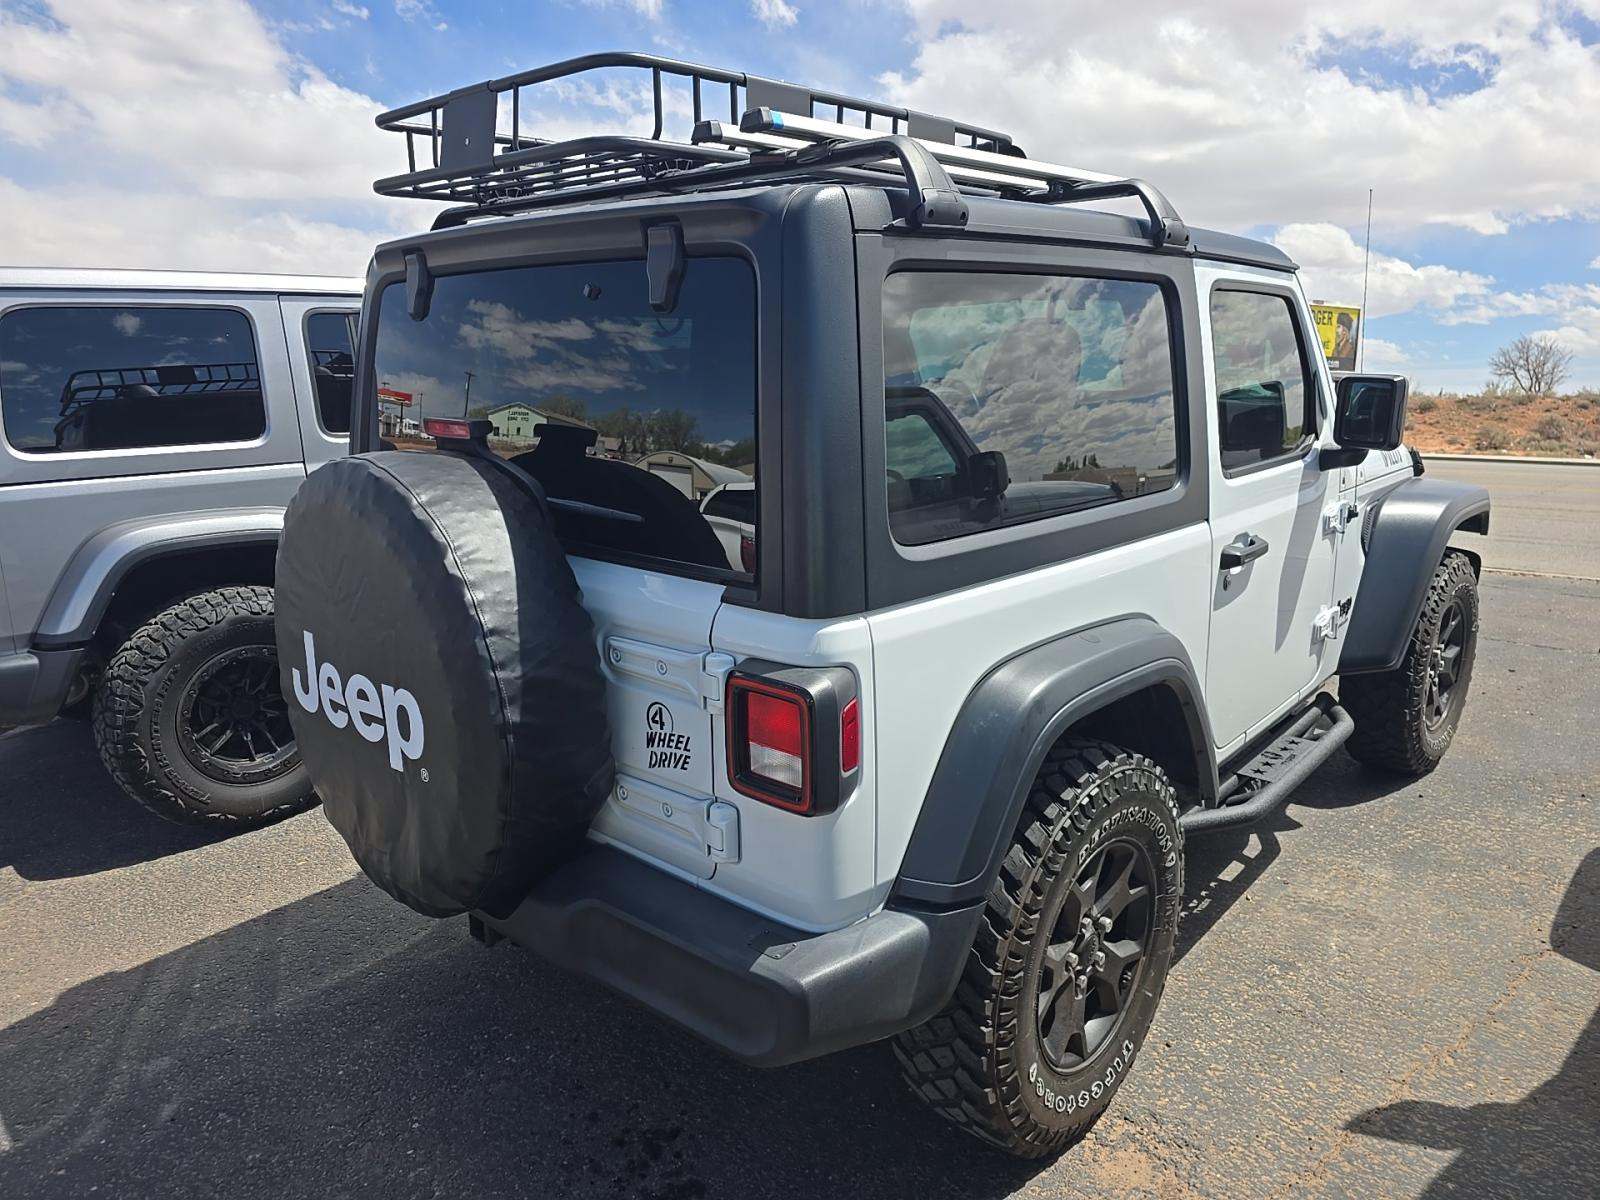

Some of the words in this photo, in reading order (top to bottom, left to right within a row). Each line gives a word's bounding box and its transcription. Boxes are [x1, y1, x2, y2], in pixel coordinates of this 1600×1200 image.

[291, 630, 425, 772] Jeep
[646, 731, 691, 752] WHEEL
[648, 750, 691, 771] DRIVE
